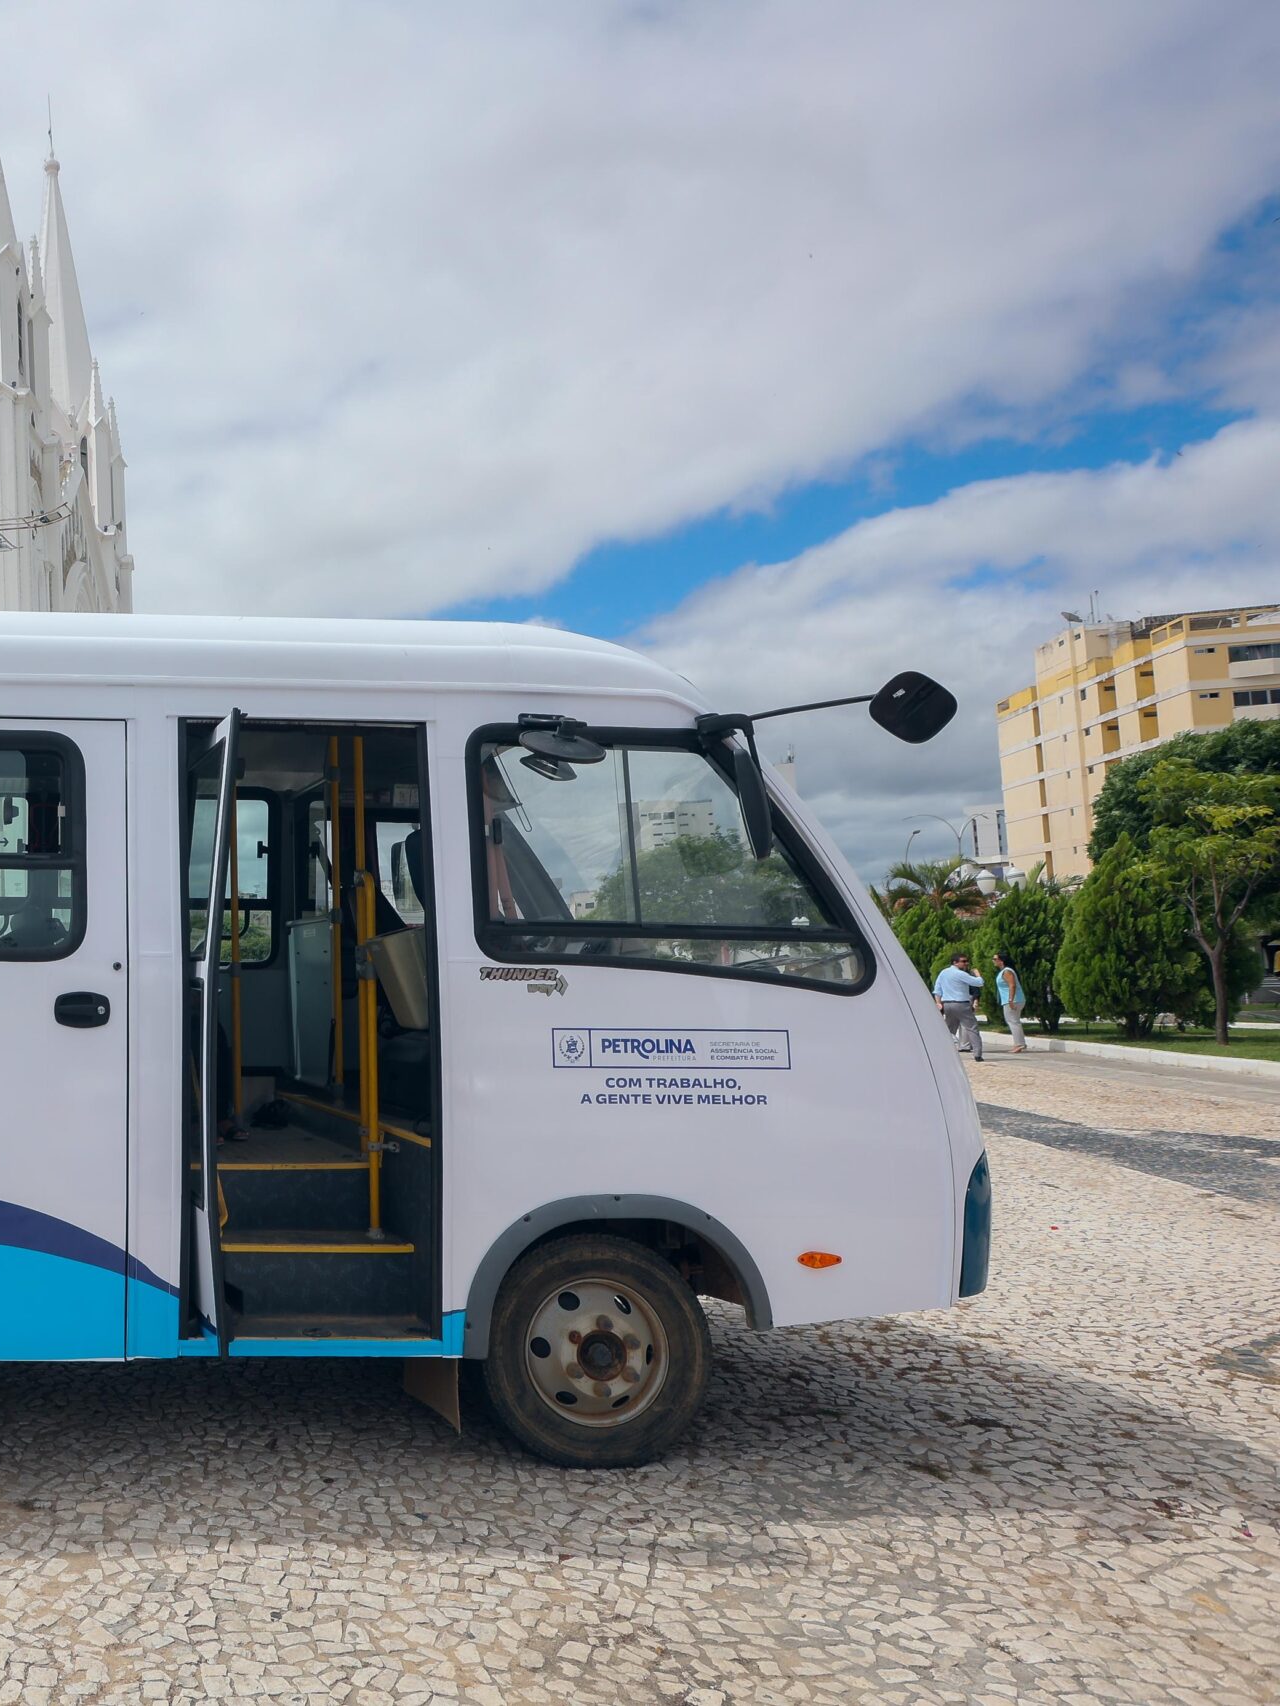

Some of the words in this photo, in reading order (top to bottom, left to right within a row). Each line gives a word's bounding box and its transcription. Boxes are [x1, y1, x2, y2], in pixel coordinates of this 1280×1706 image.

[480, 967, 559, 981] THUNDER
[601, 1038, 696, 1060] PETROLINA
[605, 1077, 642, 1089] COM
[646, 1077, 741, 1091] TRABALHO,
[580, 1093, 592, 1105] A
[595, 1093, 652, 1105] GENTE
[655, 1094, 694, 1105] VIVE
[697, 1094, 768, 1106] MELHOR
